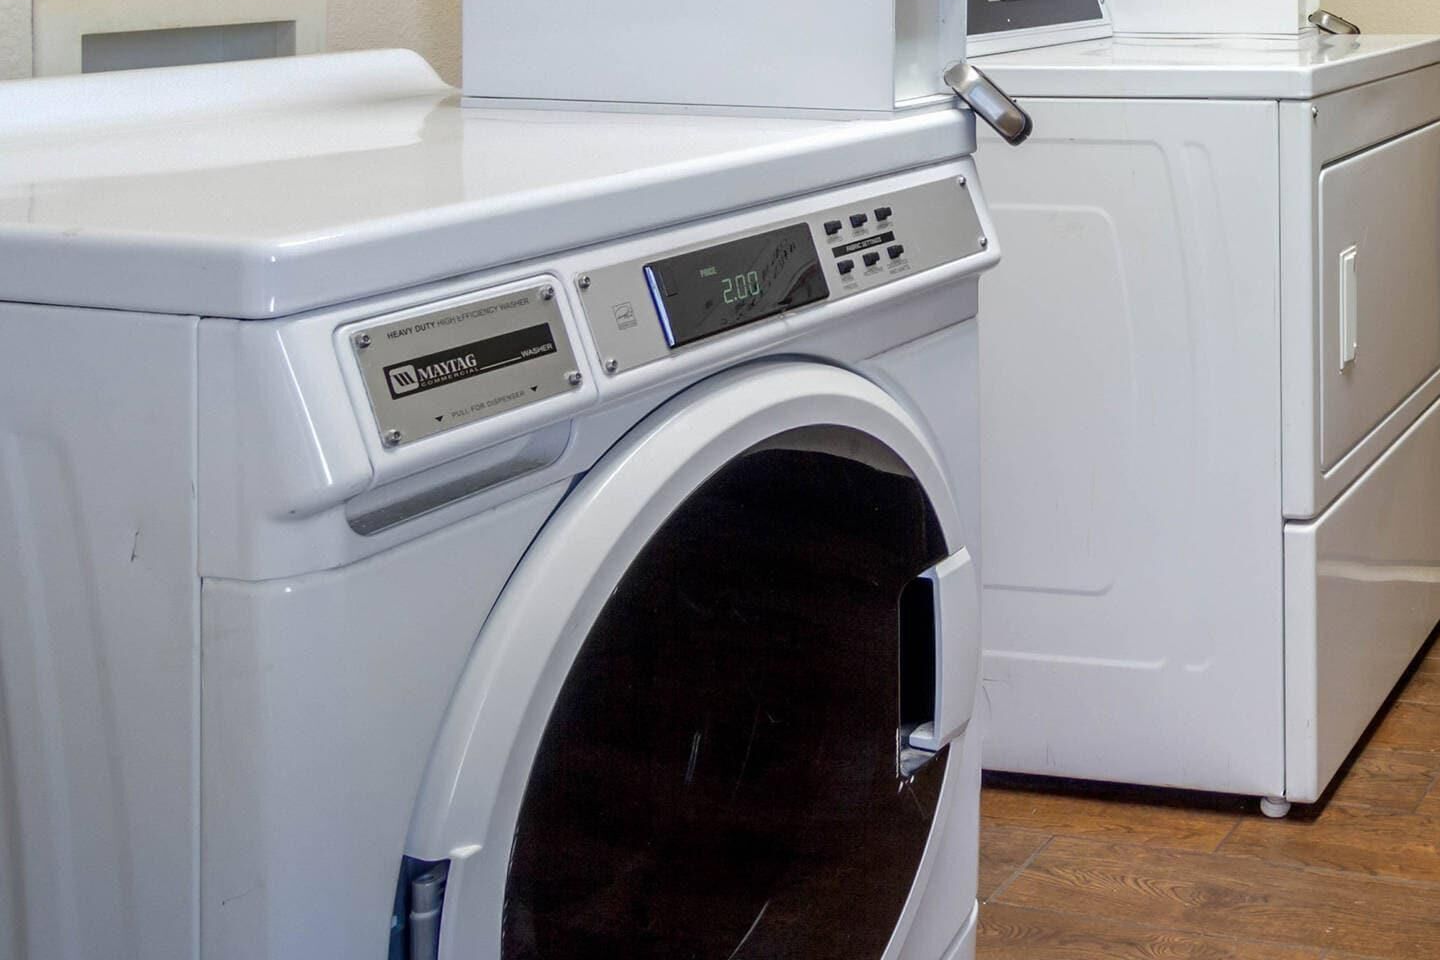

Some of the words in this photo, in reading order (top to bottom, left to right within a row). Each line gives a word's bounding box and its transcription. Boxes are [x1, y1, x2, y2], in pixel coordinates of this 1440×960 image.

[722, 271, 760, 304] 2.00
[387, 327, 413, 339] HEAVY
[415, 321, 435, 333] DUTY
[437, 316, 456, 328] HIGH
[457, 306, 498, 323] EFFICIENCY
[500, 297, 529, 311] WASHER
[418, 353, 477, 382] MAYTAG
[420, 367, 480, 388] COMMERCIAL
[520, 343, 553, 358] WASHER
[471, 401, 485, 413] FOR
[486, 390, 525, 407] DISPENSER
